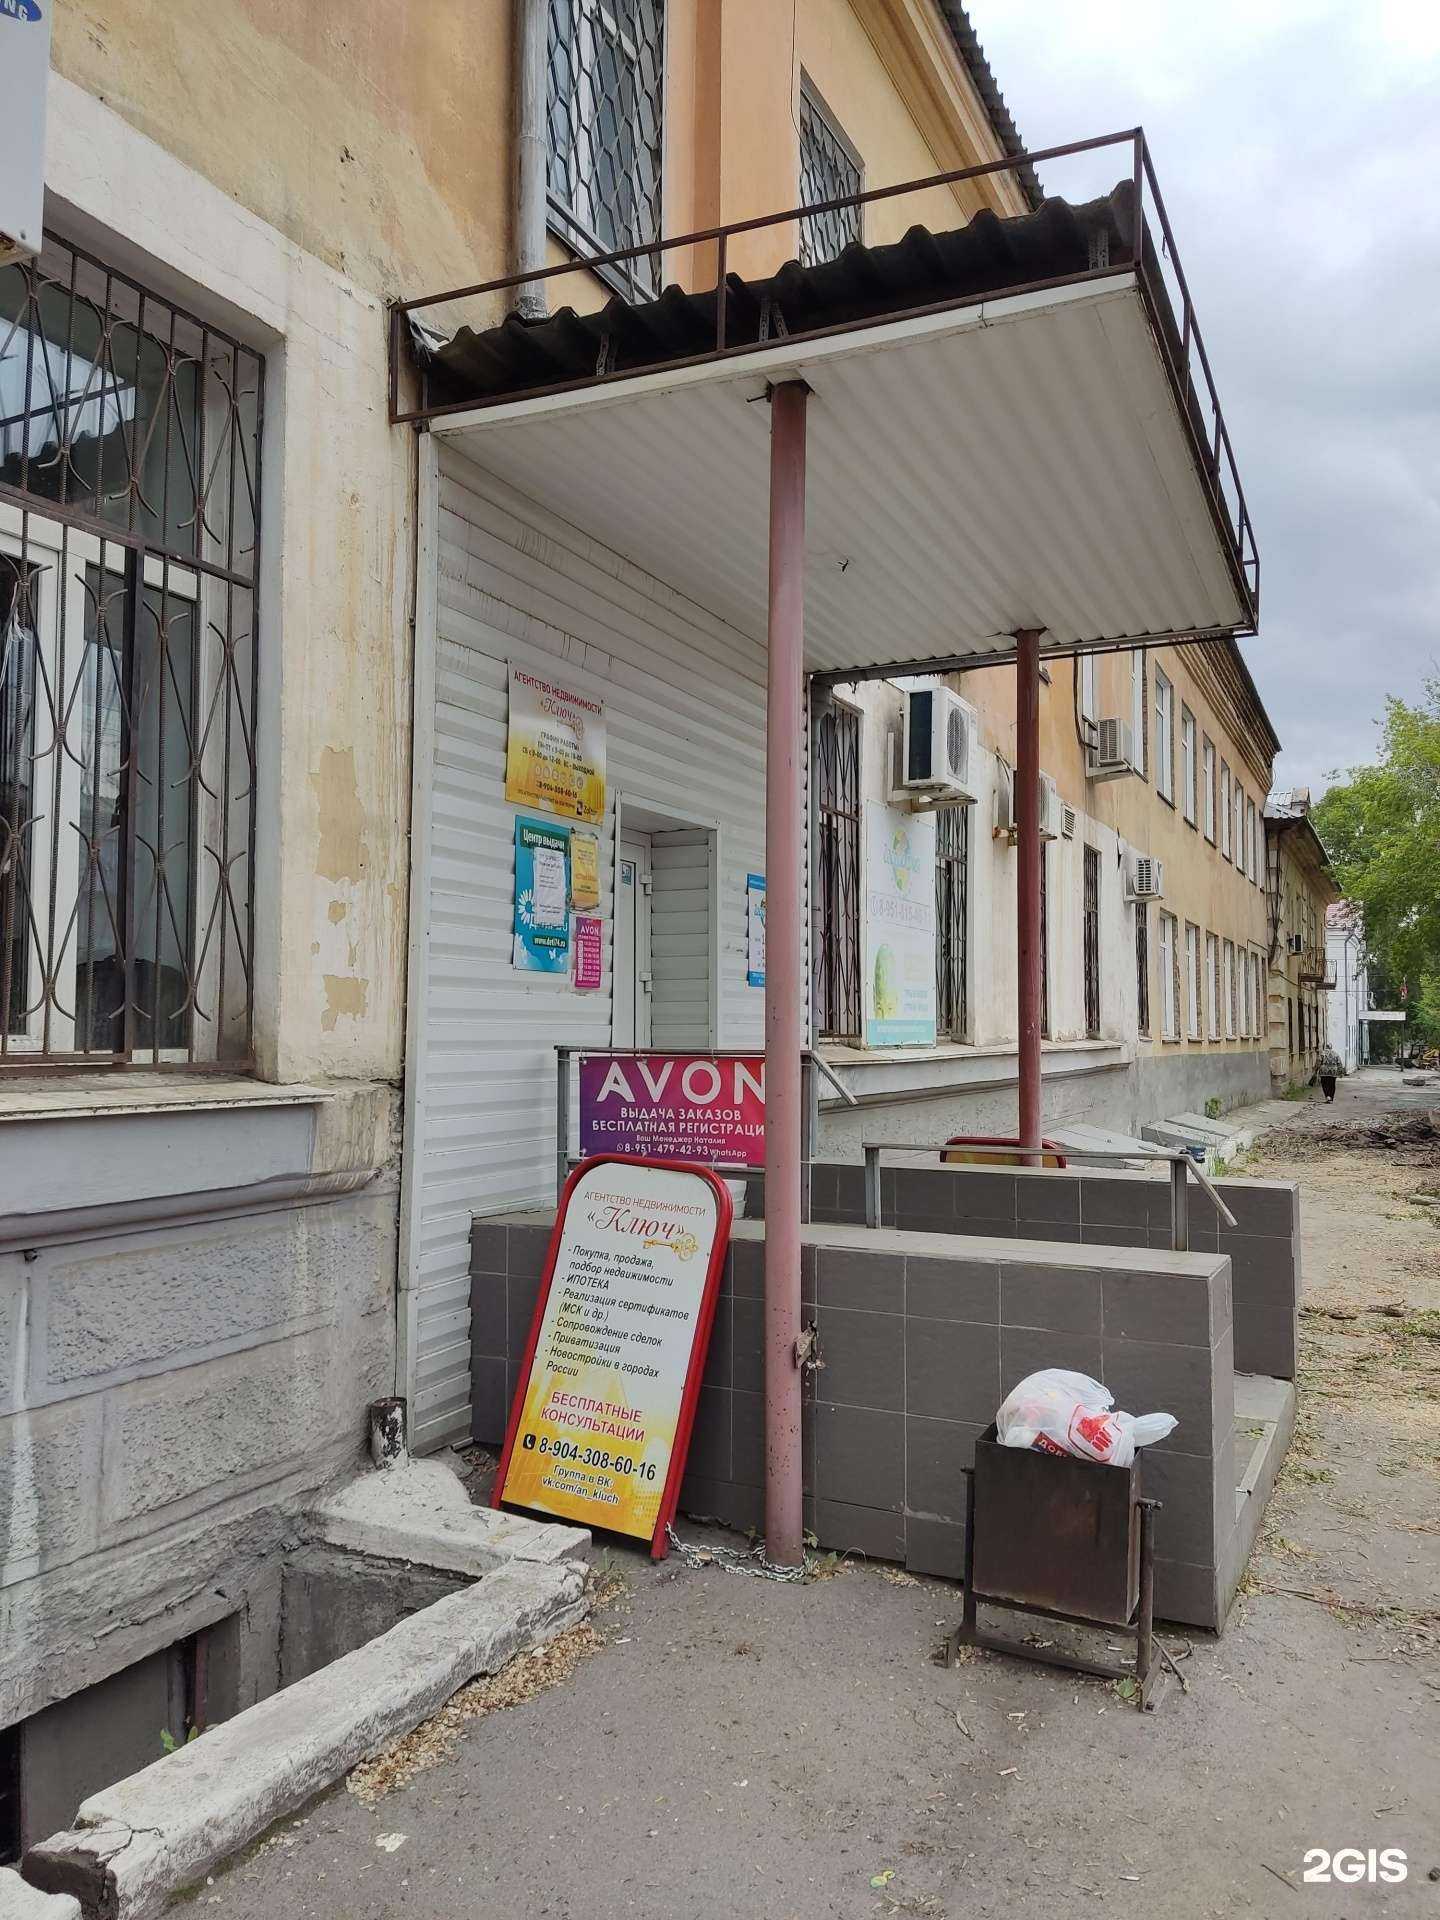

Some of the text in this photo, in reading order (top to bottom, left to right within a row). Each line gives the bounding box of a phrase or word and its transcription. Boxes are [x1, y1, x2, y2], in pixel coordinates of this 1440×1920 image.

[514, 671, 602, 715] АГЕНТСТВО НЕДВИЖИМОСТИ
[572, 762, 595, 776] ВЫХОДНОЙ
[523, 828, 541, 846] Центр
[542, 836, 565, 850] выдачи
[580, 925, 599, 935] AVON
[596, 1060, 765, 1104] AVON
[621, 1107, 742, 1121] ВЫДАЧА ЗАКАЗОВ
[592, 1120, 765, 1136] БЕСПЛАТНАЯ РЕГИСТРАЦИ
[636, 1134, 726, 1145] Ваш Менеджер Наталия
[624, 1143, 747, 1158] 8-951-479-42-93 WhatsApp
[584, 1191, 706, 1217] АГЕНТСТВО НЕДВИЖИМОСТИ
[587, 1206, 685, 1239] «Ключ»
[572, 1245, 611, 1262] Покупка,
[613, 1253, 654, 1270] продажа,
[566, 1273, 609, 1290] ИПОТЕКА
[569, 1260, 674, 1287] подбор недвижимости
[558, 1301, 609, 1322] (МСК и др.)
[563, 1287, 617, 1307] Реализация
[618, 1299, 690, 1321] сертификатов
[552, 1331, 621, 1354] Приватизация
[556, 1316, 629, 1340] Сопровождение
[630, 1330, 663, 1347] сделок
[546, 1360, 579, 1377] России
[549, 1345, 612, 1369] Новостройки
[613, 1361, 620, 1369] в
[621, 1363, 660, 1378] городах
[551, 1391, 643, 1423] БЕСПЛАТНЫЕ
[541, 1407, 646, 1442] КОНСУЛЬТАЦИИ
[538, 1437, 657, 1481] 8-904-308-60-16
[553, 1464, 614, 1488] Группа в ВК:
[542, 1476, 619, 1504] vk.com/an_kluch
